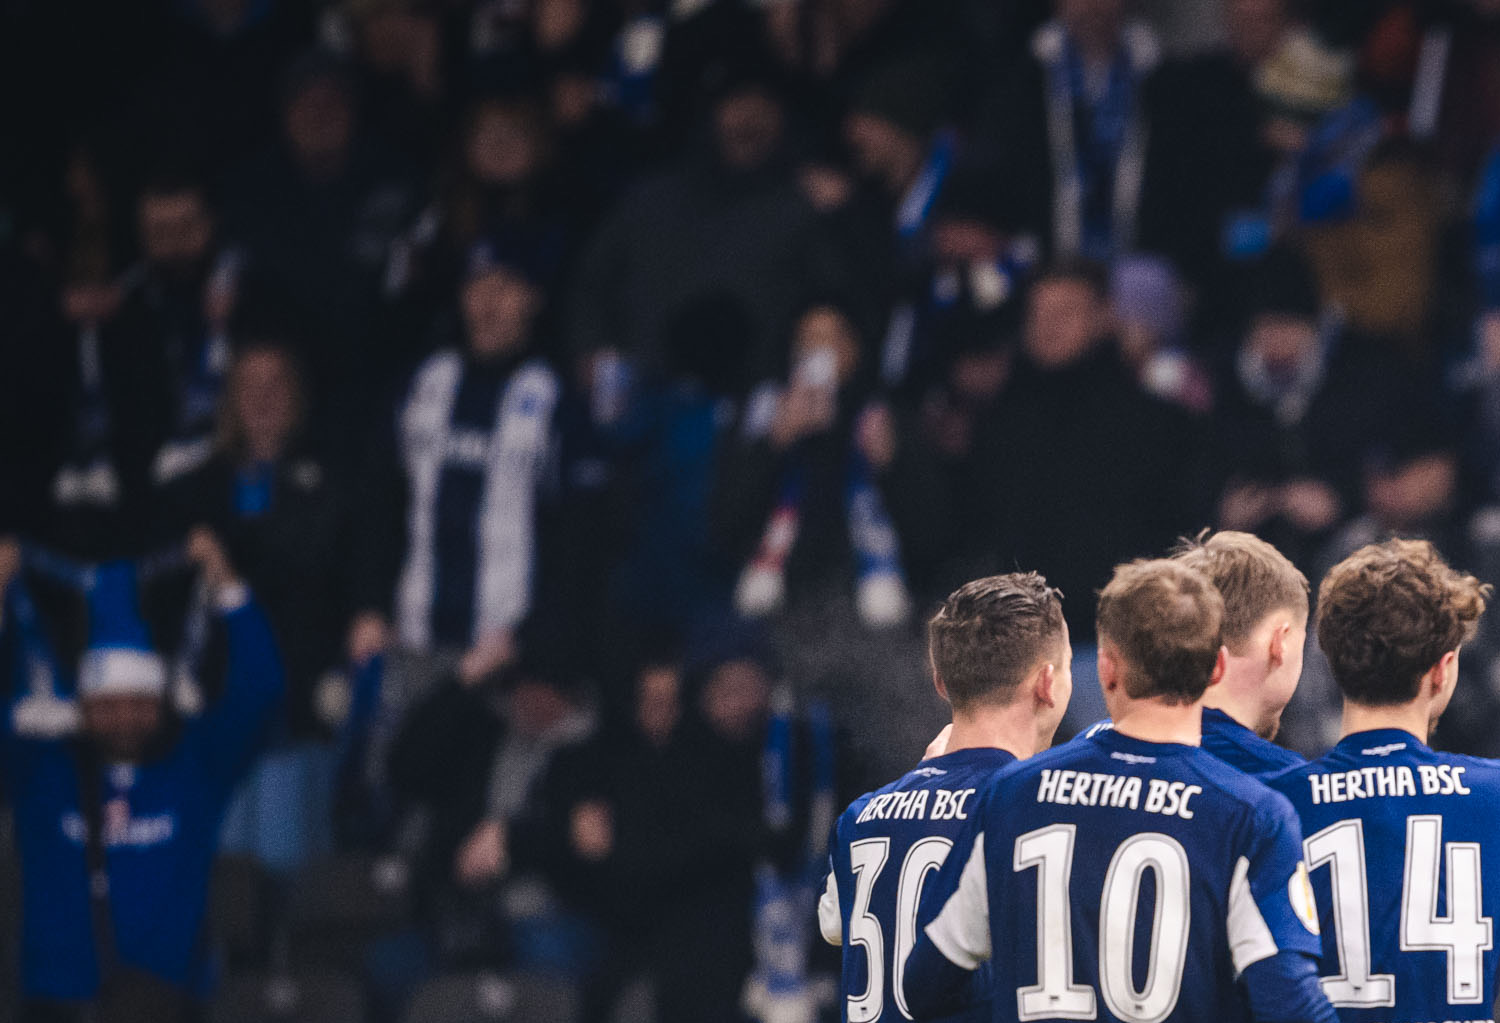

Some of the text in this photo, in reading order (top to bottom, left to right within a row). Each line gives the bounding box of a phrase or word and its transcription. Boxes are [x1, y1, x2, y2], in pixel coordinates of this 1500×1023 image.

[856, 788, 977, 824] HERTHA BSC
[1037, 769, 1203, 819] HERTHA BSC
[1309, 765, 1471, 804] HERTHA BSC
[1302, 814, 1494, 1008] 14
